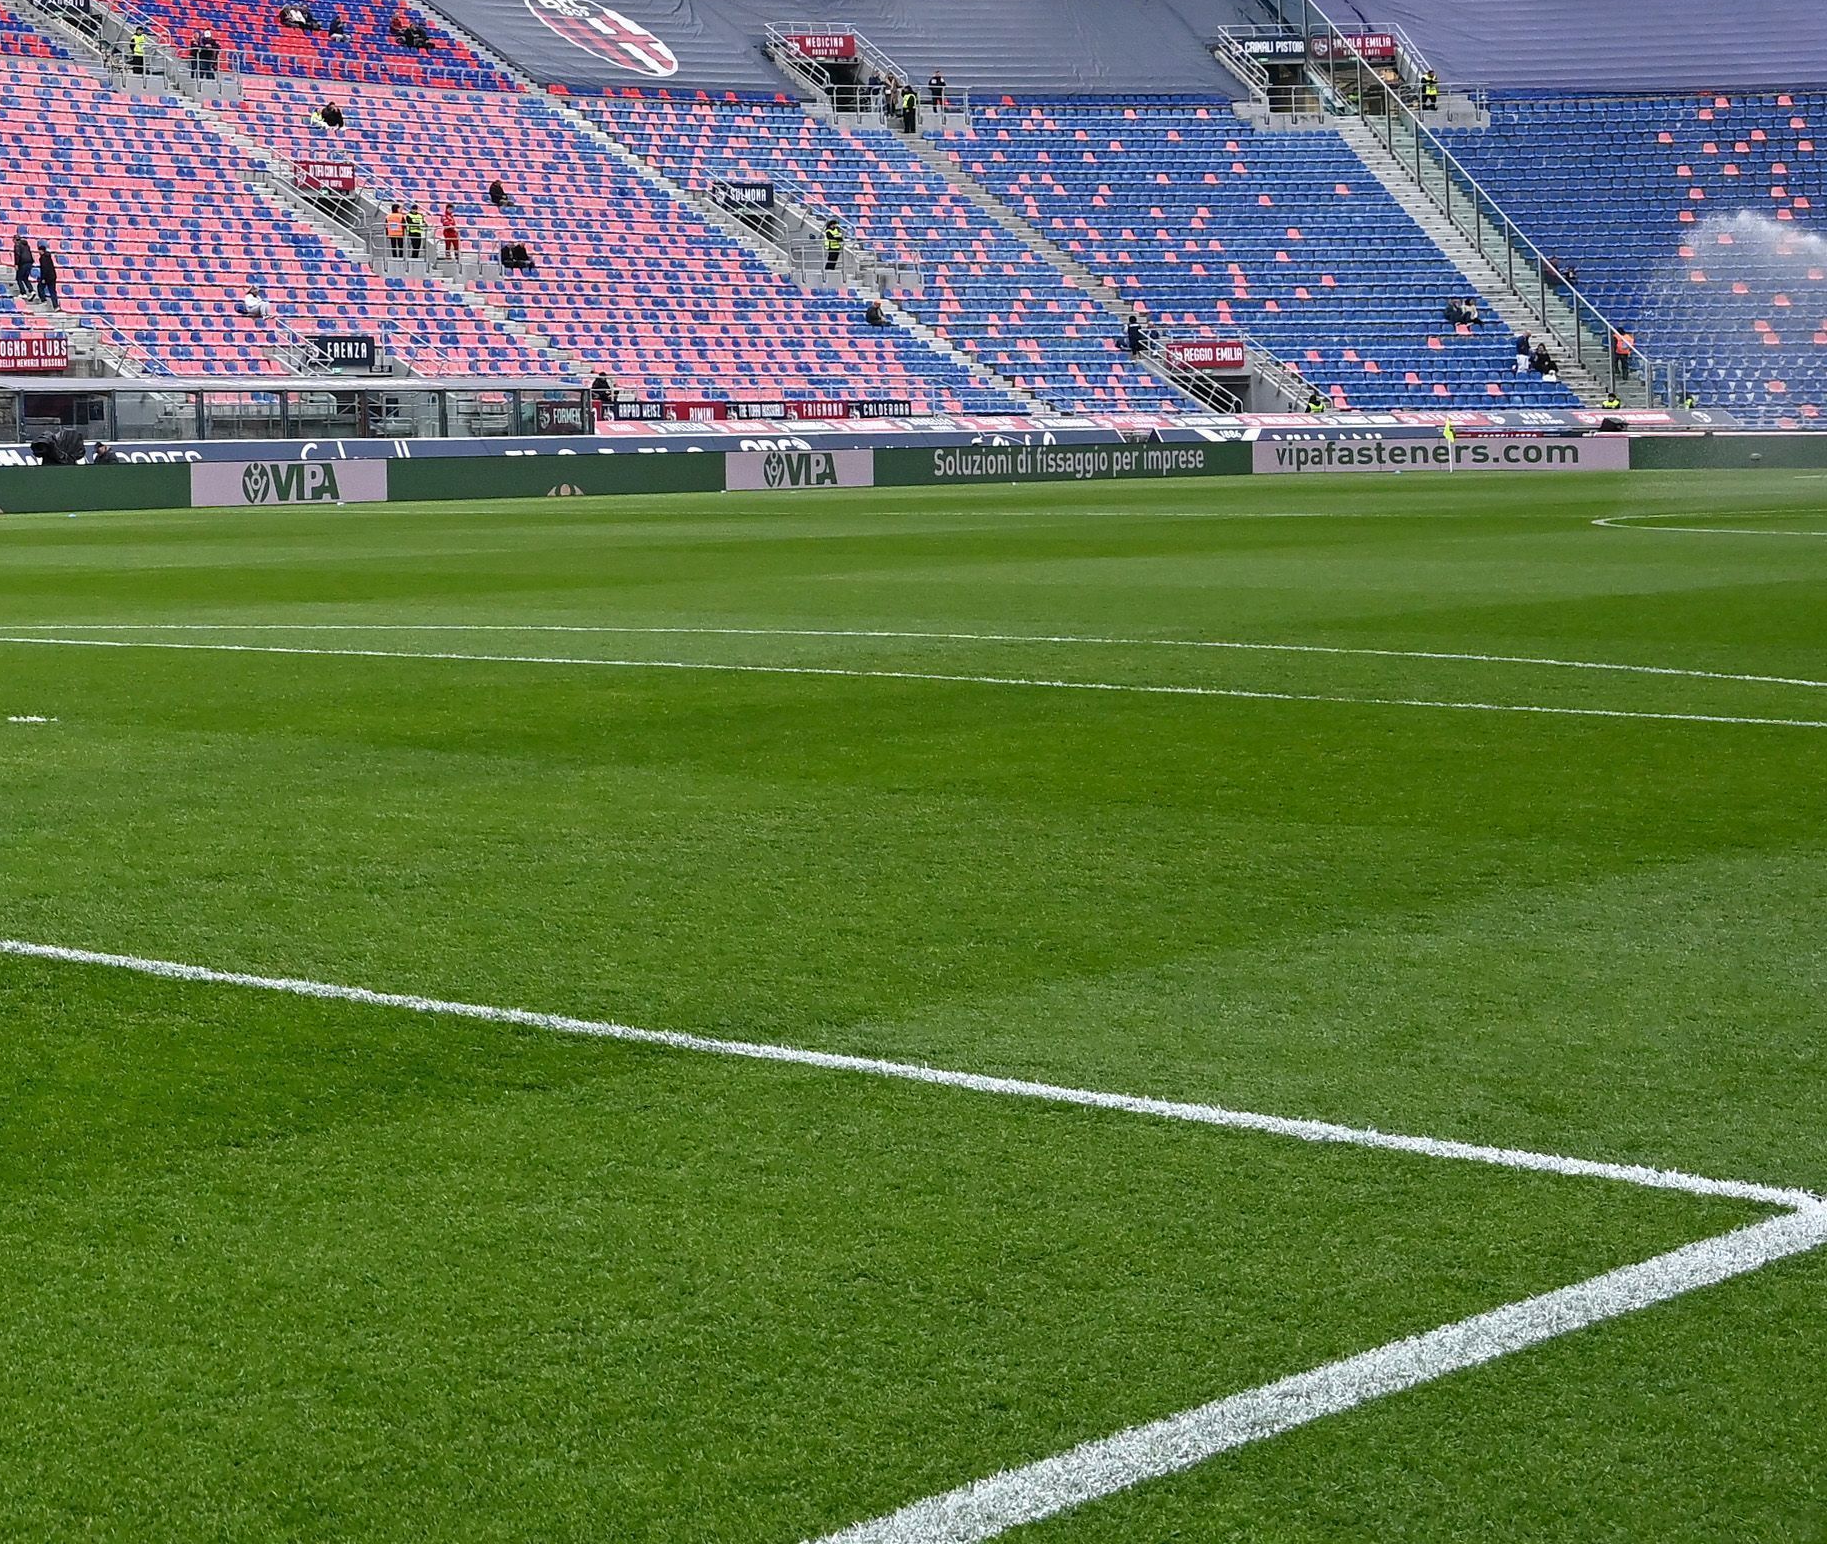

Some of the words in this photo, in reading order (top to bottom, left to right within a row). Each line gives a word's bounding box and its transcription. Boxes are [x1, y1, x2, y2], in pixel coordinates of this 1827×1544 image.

[806, 37, 843, 47] MEDICINA
[1276, 41, 1304, 53] PISTOIA
[1365, 37, 1391, 47] EMILIA
[32, 340, 67, 356] CLUBS
[328, 342, 367, 358] FAENZA
[1184, 347, 1212, 361] REGGIO
[1216, 347, 1243, 361] EMILIA
[689, 407, 715, 421] RIMINI
[803, 403, 843, 417] FRIGNANO
[863, 403, 909, 416] CALDERARA
[934, 448, 1012, 476] Soluzioni
[1017, 447, 1032, 474] di
[1037, 446, 1108, 479] fissaggio
[1113, 450, 1138, 477] per
[1143, 445, 1204, 475] imprese
[1275, 440, 1580, 470] vipafasteners.com
[785, 452, 837, 486] VIPA
[270, 463, 340, 501] VIPA
